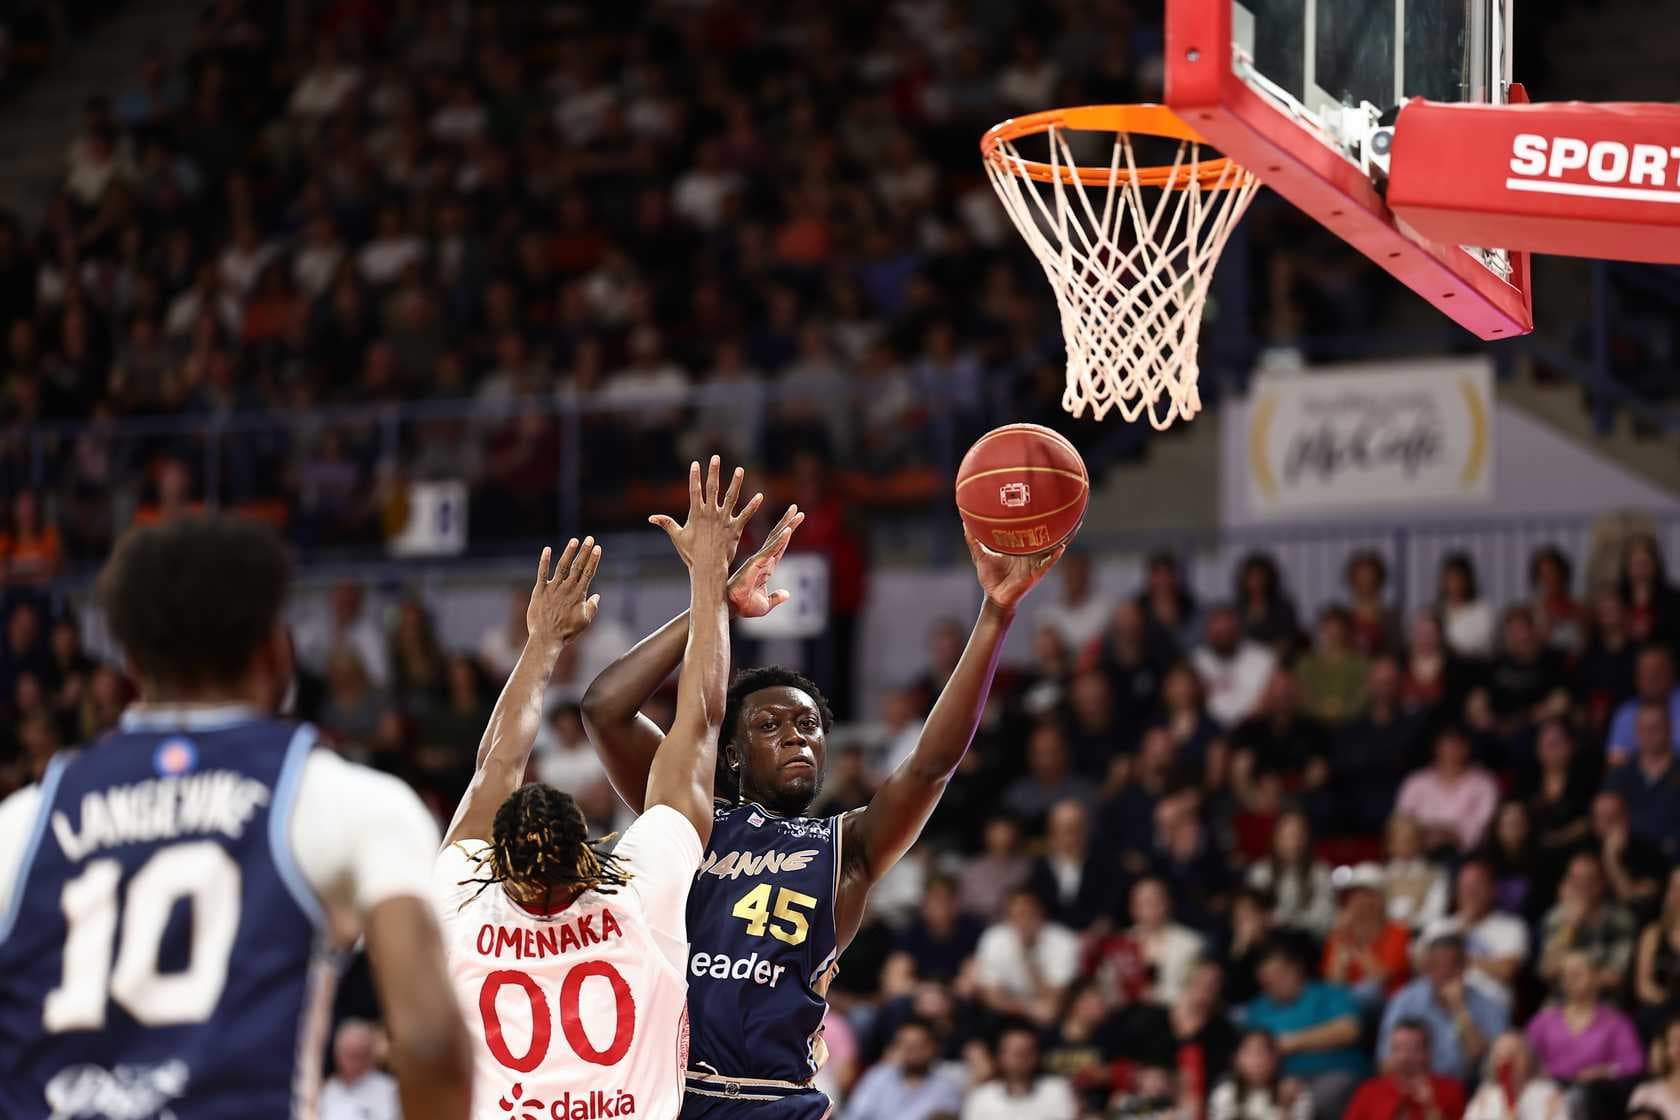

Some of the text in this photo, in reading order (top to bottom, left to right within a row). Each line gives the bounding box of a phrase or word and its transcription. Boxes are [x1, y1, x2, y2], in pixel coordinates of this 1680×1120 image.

[42, 839, 242, 1033] 10
[476, 908, 623, 960] OMENAKA
[731, 882, 818, 946] 45
[686, 942, 786, 988] eader
[478, 959, 636, 1073] 00
[550, 1089, 636, 1120] dalkia
